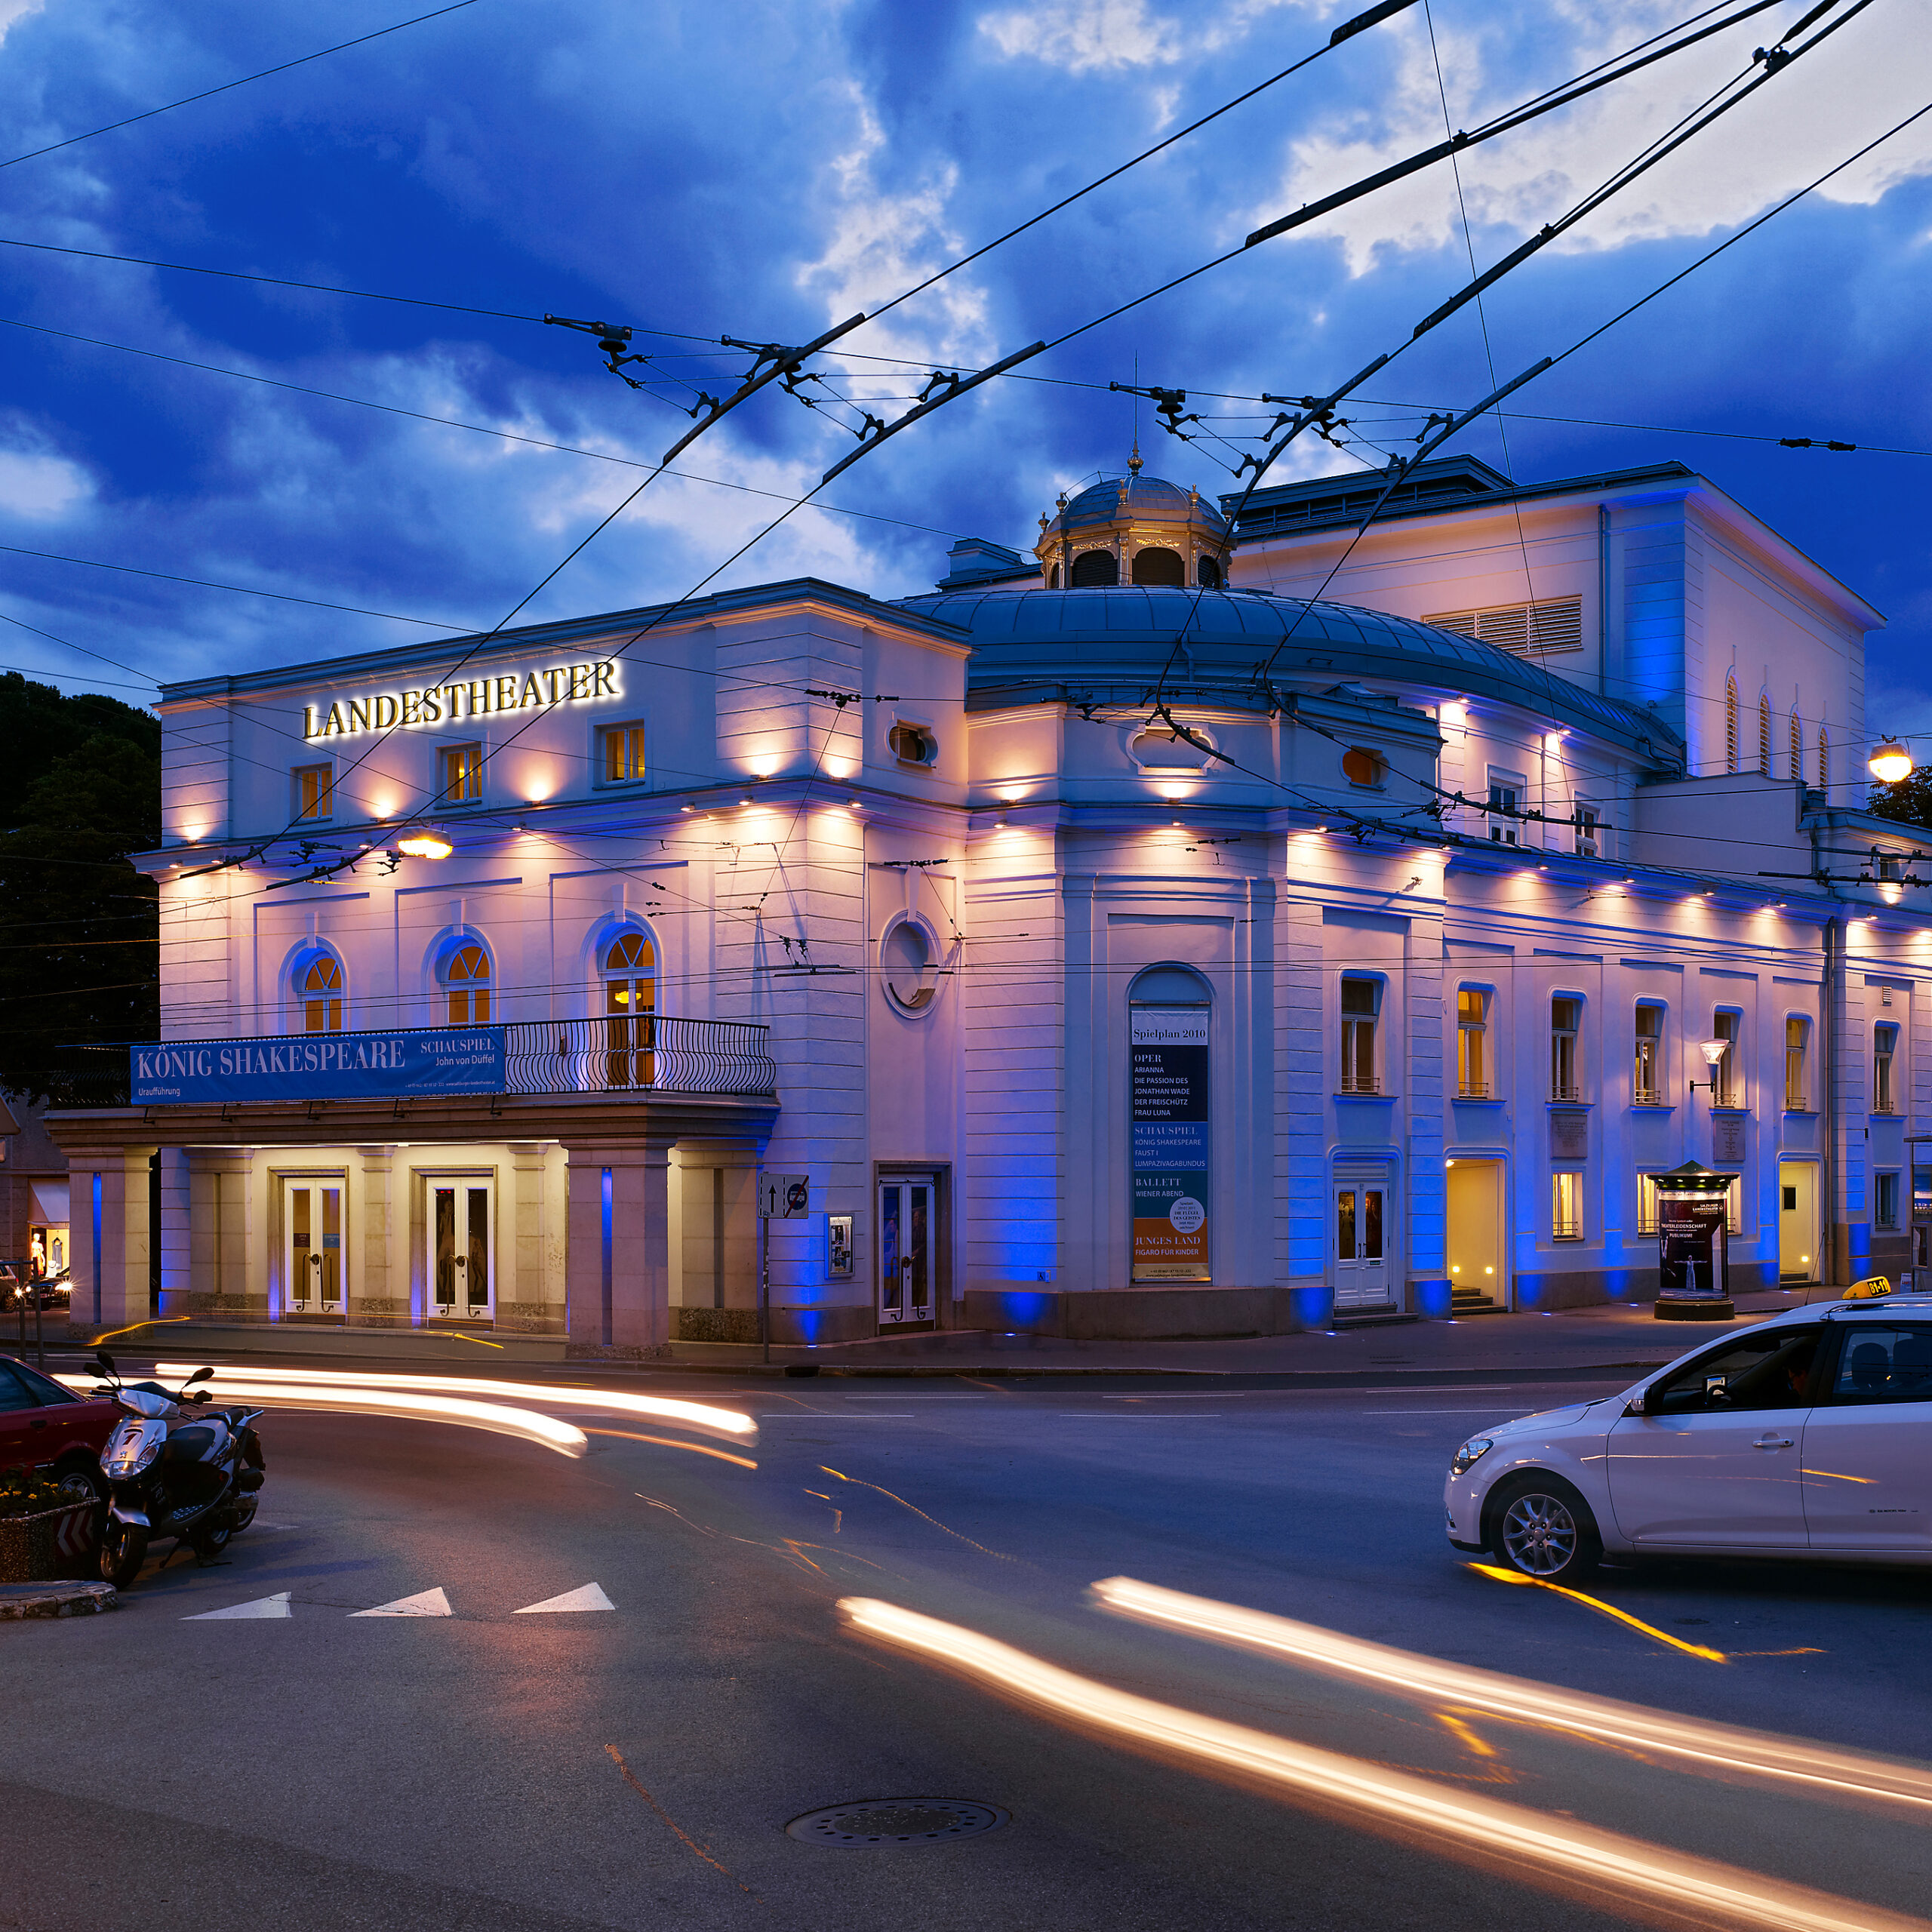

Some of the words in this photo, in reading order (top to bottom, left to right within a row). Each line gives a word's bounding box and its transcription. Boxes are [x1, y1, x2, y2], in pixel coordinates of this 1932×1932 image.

[302, 661, 620, 740] LANDESTHEATER
[1134, 1029, 1180, 1040] Spielplan
[1183, 1029, 1206, 1038] 2010
[420, 1038, 495, 1054] SCHAUSPIEL
[137, 1045, 213, 1079] KÖNIG
[220, 1040, 406, 1076] SHAKESPEARE
[435, 1057, 454, 1067] John
[455, 1057, 469, 1066] von
[471, 1054, 495, 1065] Düffel
[1134, 1054, 1161, 1063] OPER
[138, 1086, 181, 1097] Uraufführung
[1135, 1127, 1198, 1135] SCHAUSPIEL
[1136, 1178, 1181, 1186] BALLETT
[1136, 1237, 1172, 1245] JUNGES
[1174, 1237, 1201, 1245] LAND
[1869, 1279, 1888, 1294] 81-11
